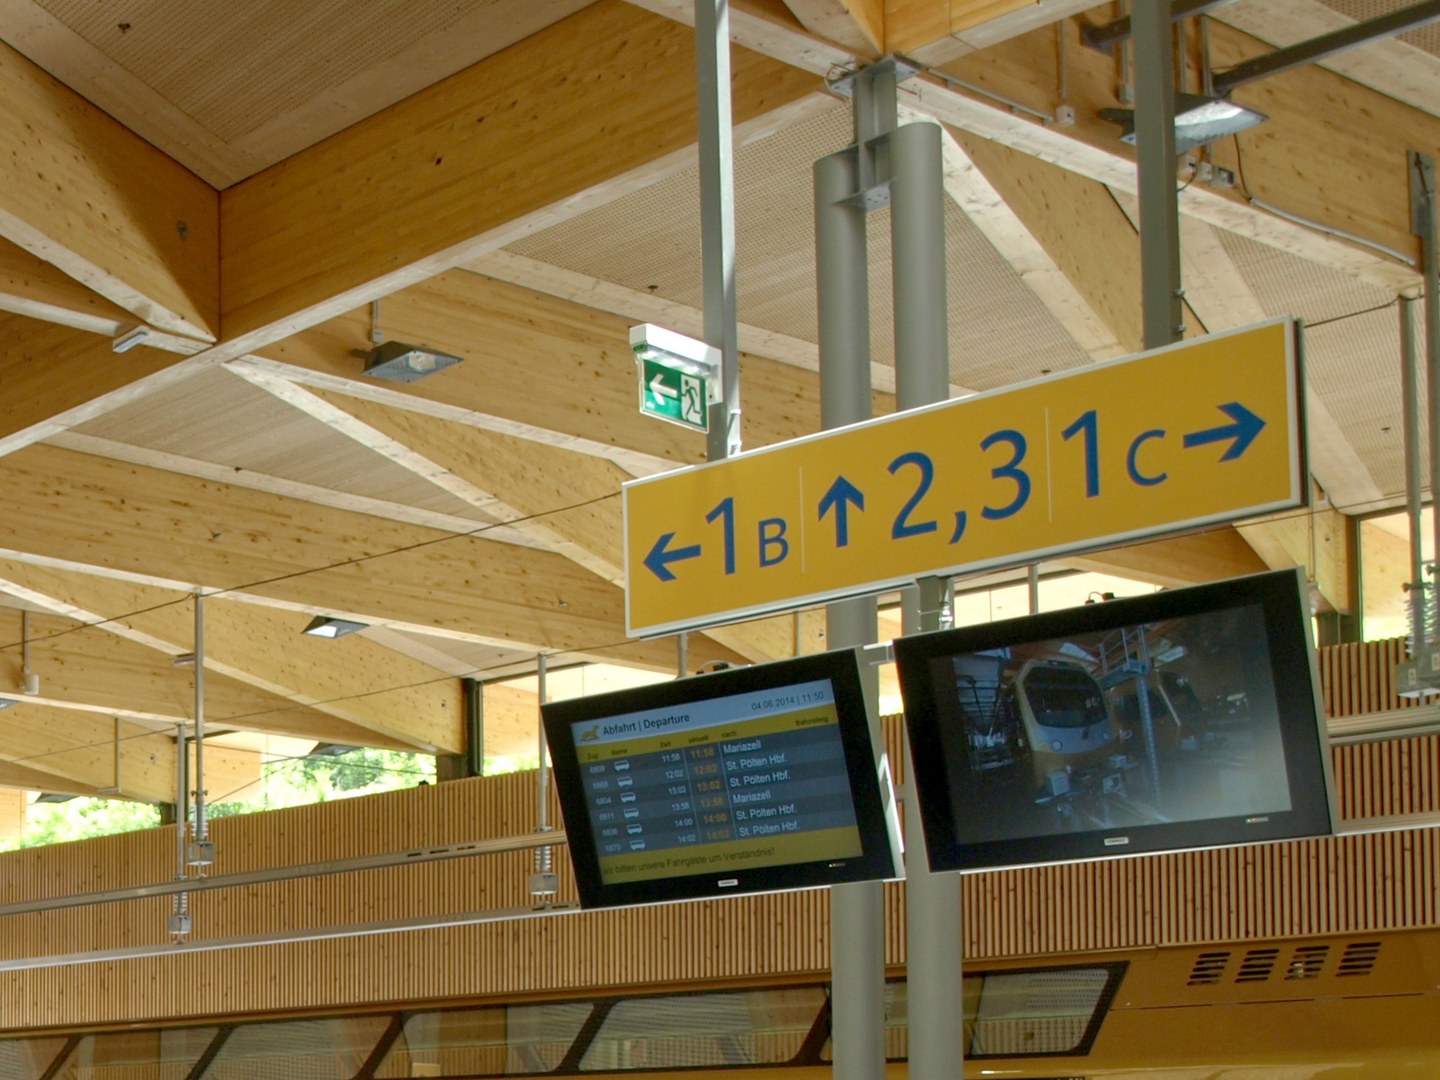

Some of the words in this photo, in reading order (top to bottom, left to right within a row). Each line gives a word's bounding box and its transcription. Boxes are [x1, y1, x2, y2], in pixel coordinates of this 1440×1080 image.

[887, 428, 1032, 546] 2,3
[801, 691, 824, 702] 11:50
[602, 721, 637, 735] Abfahrt
[642, 712, 690, 730] Departure
[662, 753, 681, 763] 11:58
[723, 739, 761, 754] Mariazell
[665, 769, 684, 779] 12:02
[726, 760, 738, 770] St.
[739, 755, 767, 769] Pölten
[768, 753, 787, 764] Hbf.
[668, 785, 687, 795] 13:02
[729, 777, 741, 787] St.
[742, 772, 770, 785] Pölten
[771, 770, 790, 781] Hbf.
[671, 801, 690, 811] 13:58
[732, 790, 771, 803] Mariazell
[674, 818, 693, 827] 14:00
[735, 810, 747, 820] St.
[748, 805, 777, 818] Pölten
[777, 803, 796, 814] Hbf.
[677, 834, 696, 844] 14:02
[738, 826, 750, 836] St.
[751, 822, 780, 835] Pölten
[781, 820, 799, 831] Hbf.
